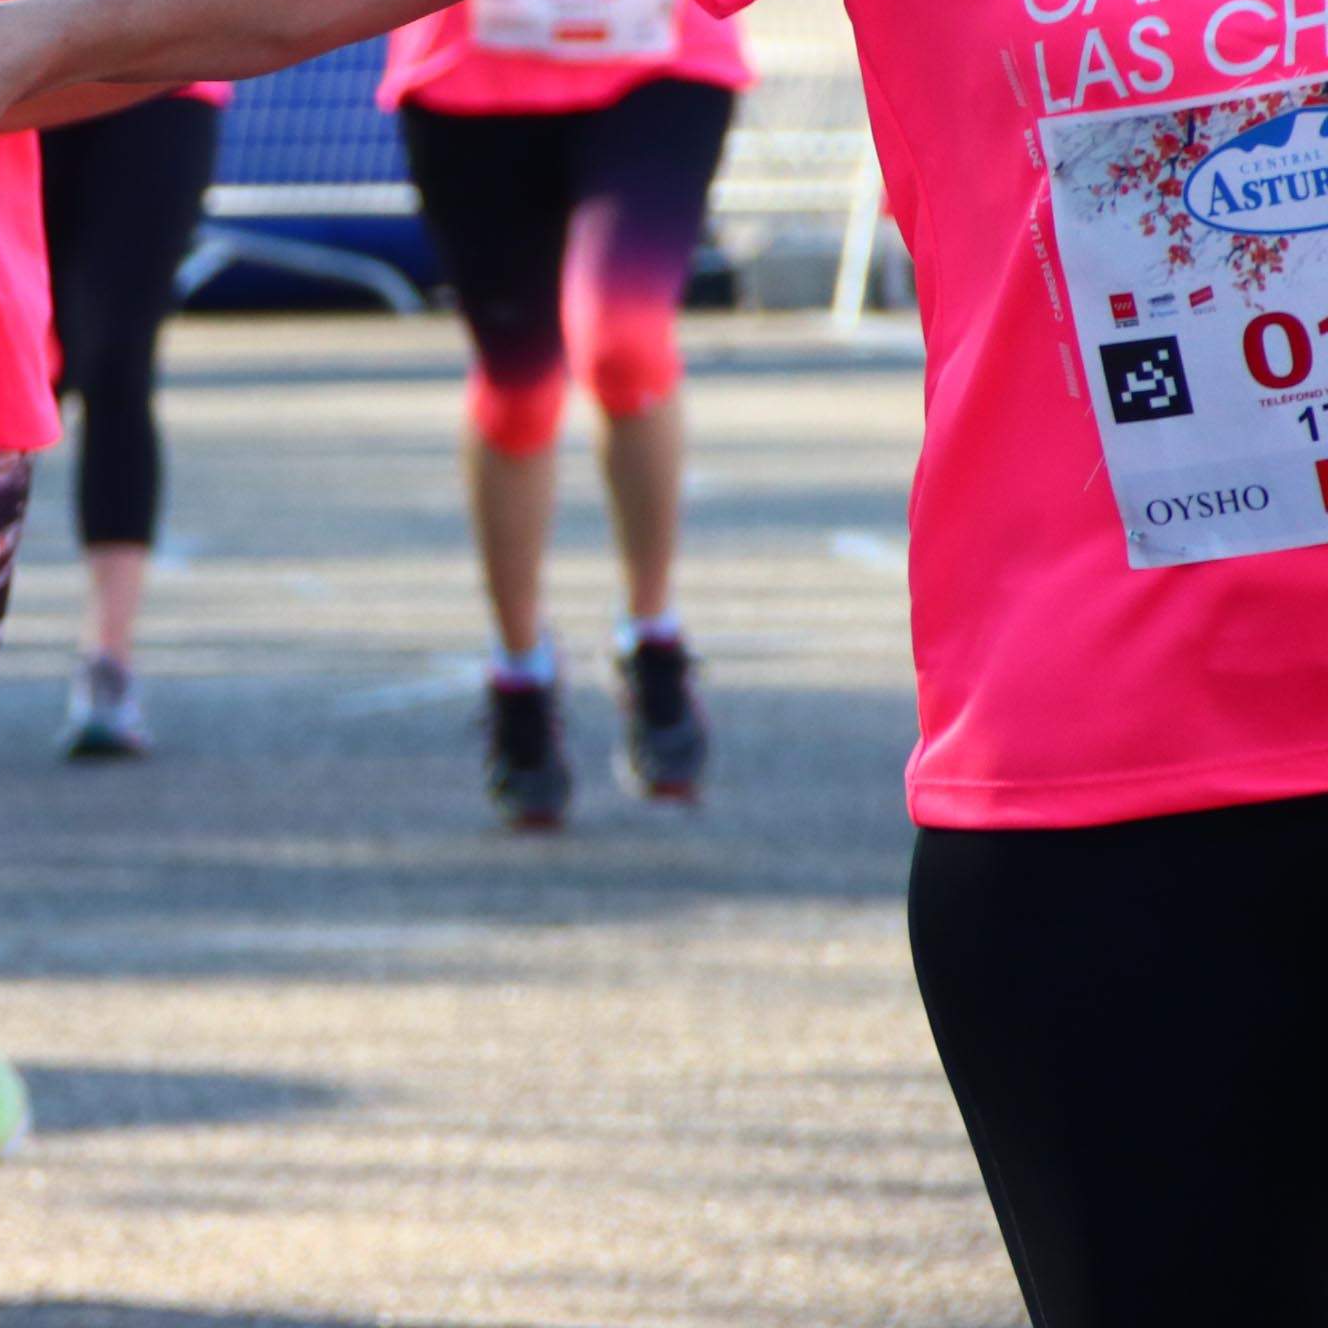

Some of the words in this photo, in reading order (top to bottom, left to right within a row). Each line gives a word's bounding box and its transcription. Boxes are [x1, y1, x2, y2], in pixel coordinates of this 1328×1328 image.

[1034, 15, 1174, 114] LAS
[1243, 311, 1328, 390] 0
[1146, 484, 1270, 526] OYSHO
